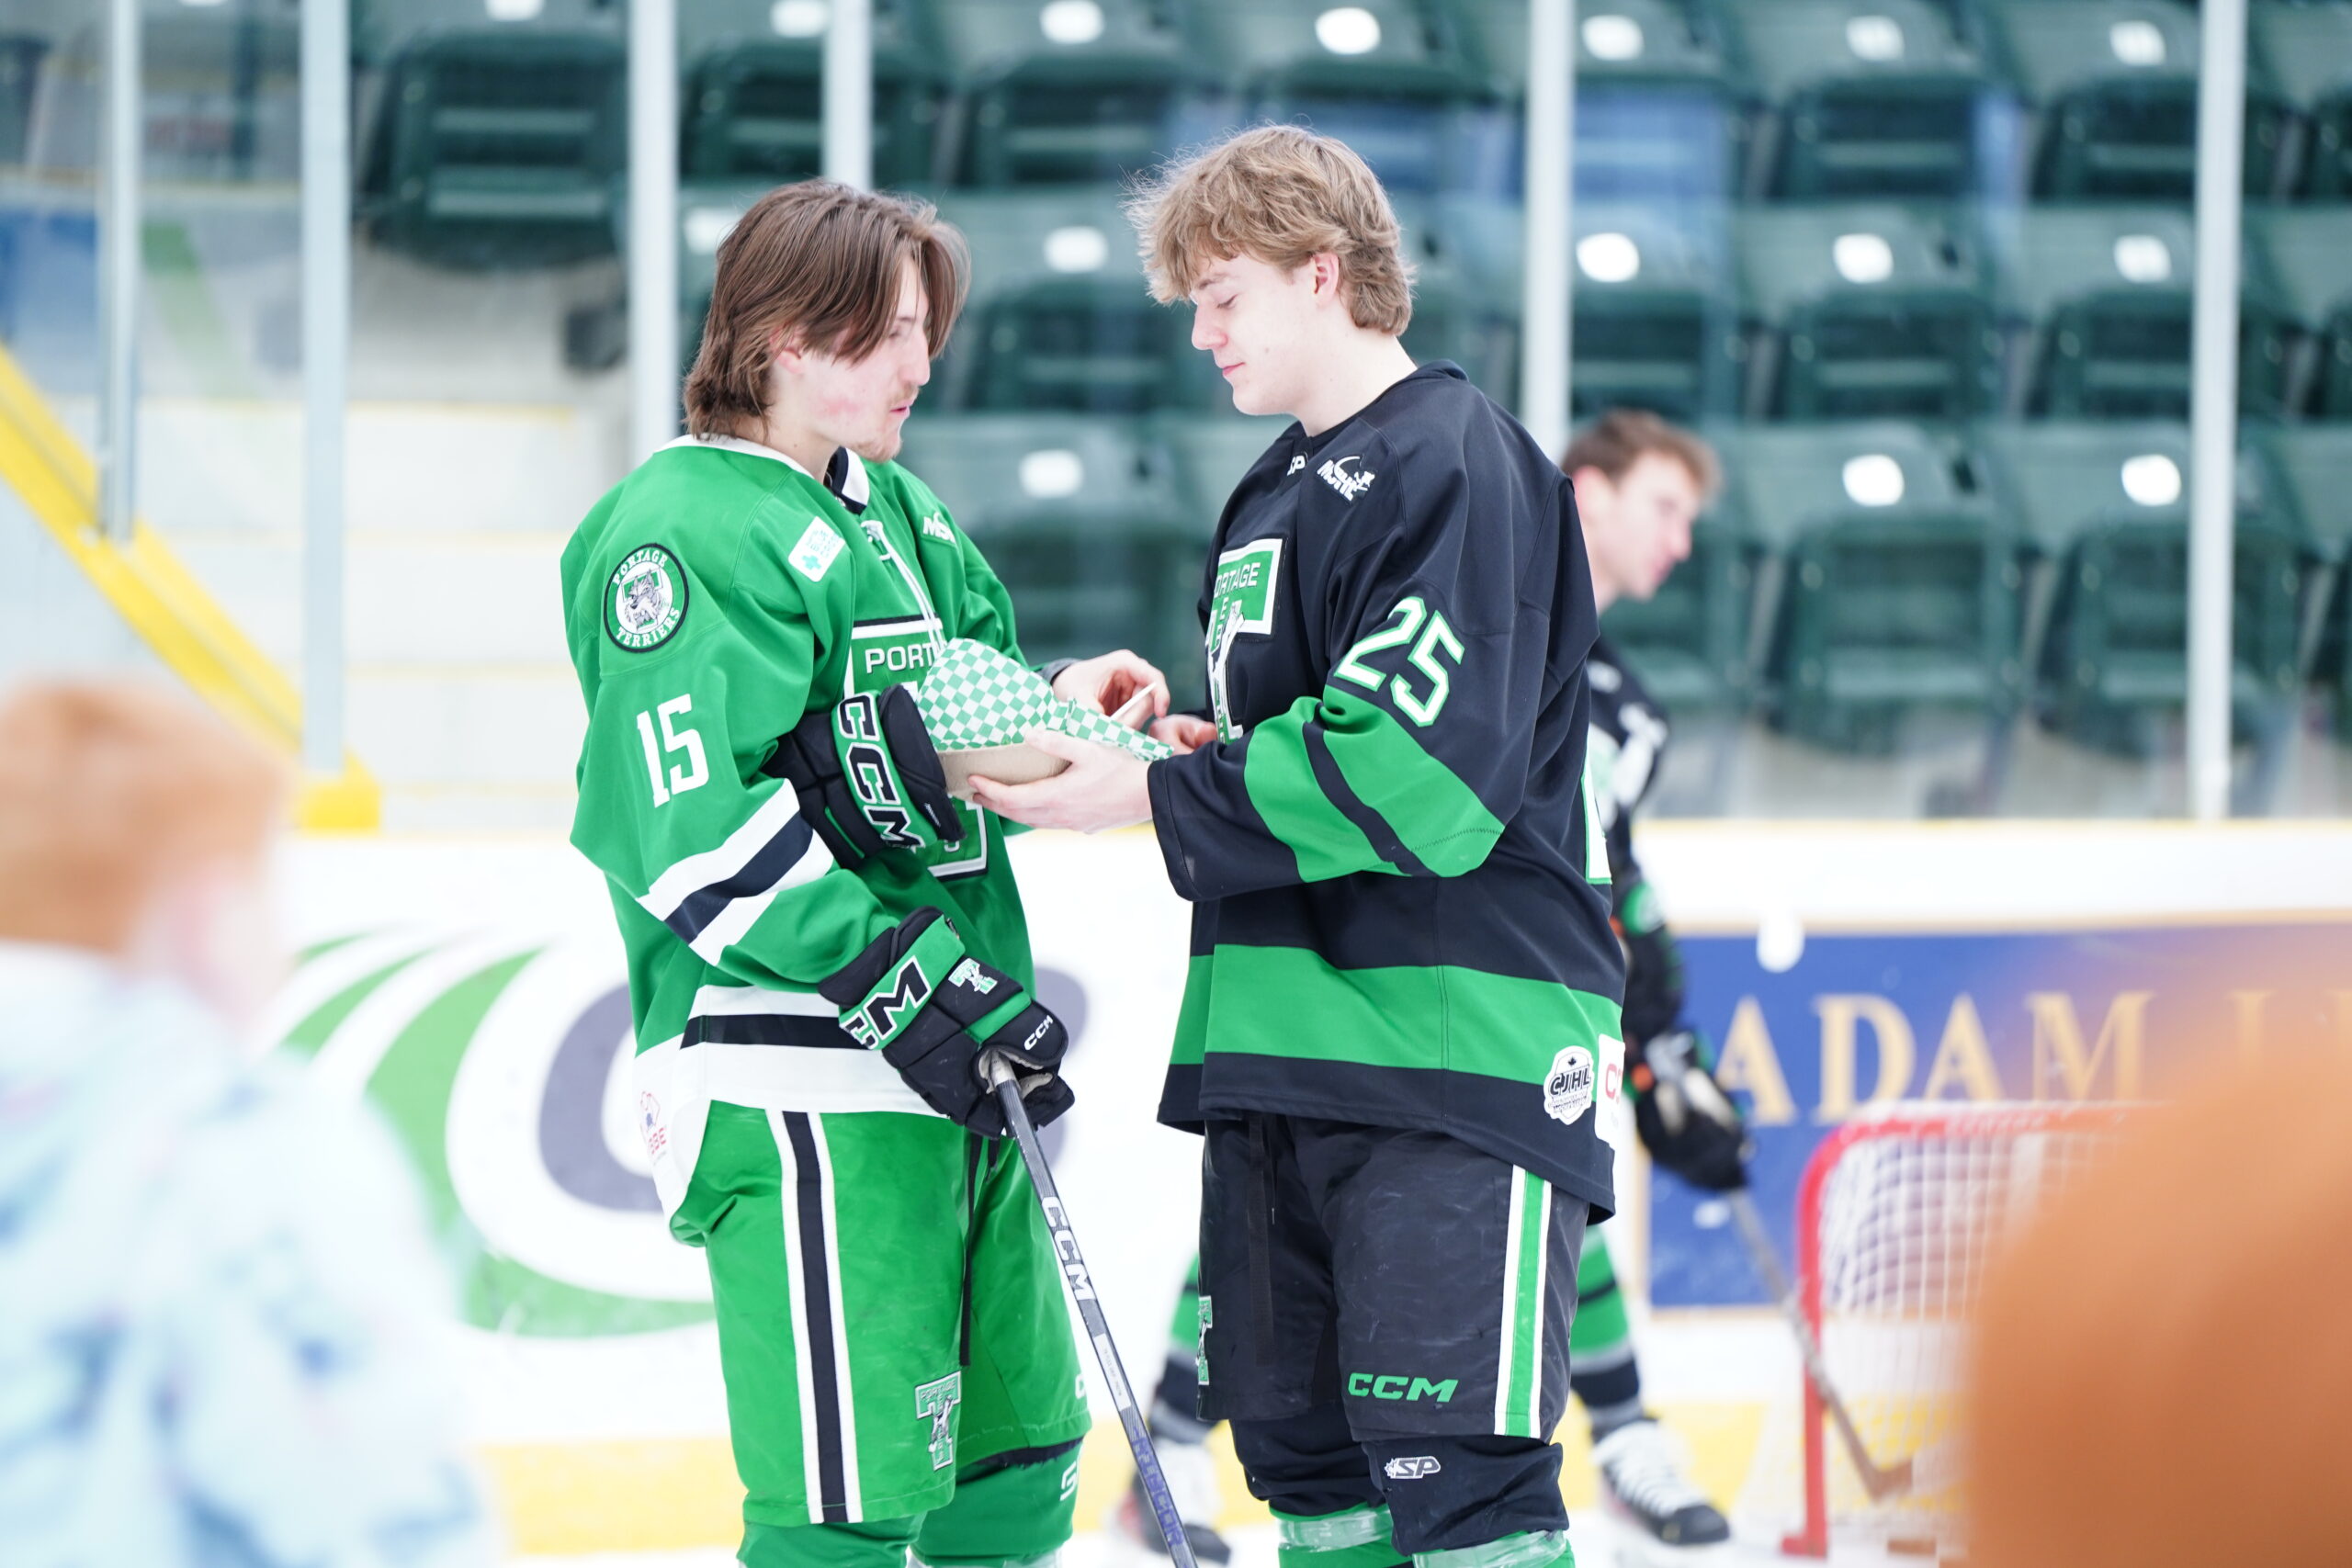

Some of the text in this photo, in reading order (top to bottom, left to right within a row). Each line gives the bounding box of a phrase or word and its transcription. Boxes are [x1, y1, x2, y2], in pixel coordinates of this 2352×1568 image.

[612, 549, 668, 586] PORTAGE
[1214, 562, 1261, 598] ORTAGE
[616, 606, 680, 647] TERRIERS
[865, 645, 935, 674] PORT
[1333, 596, 1464, 728] 25
[636, 693, 709, 808] 15
[838, 691, 927, 854] CCM
[1023, 1015, 1054, 1051] CCM
[1715, 990, 2156, 1127] ADAM
[1549, 1066, 1590, 1096] CJHL
[1041, 1196, 1097, 1301] CCM
[1348, 1372, 1459, 1403] CCM
[1385, 1456, 1442, 1479] SP
